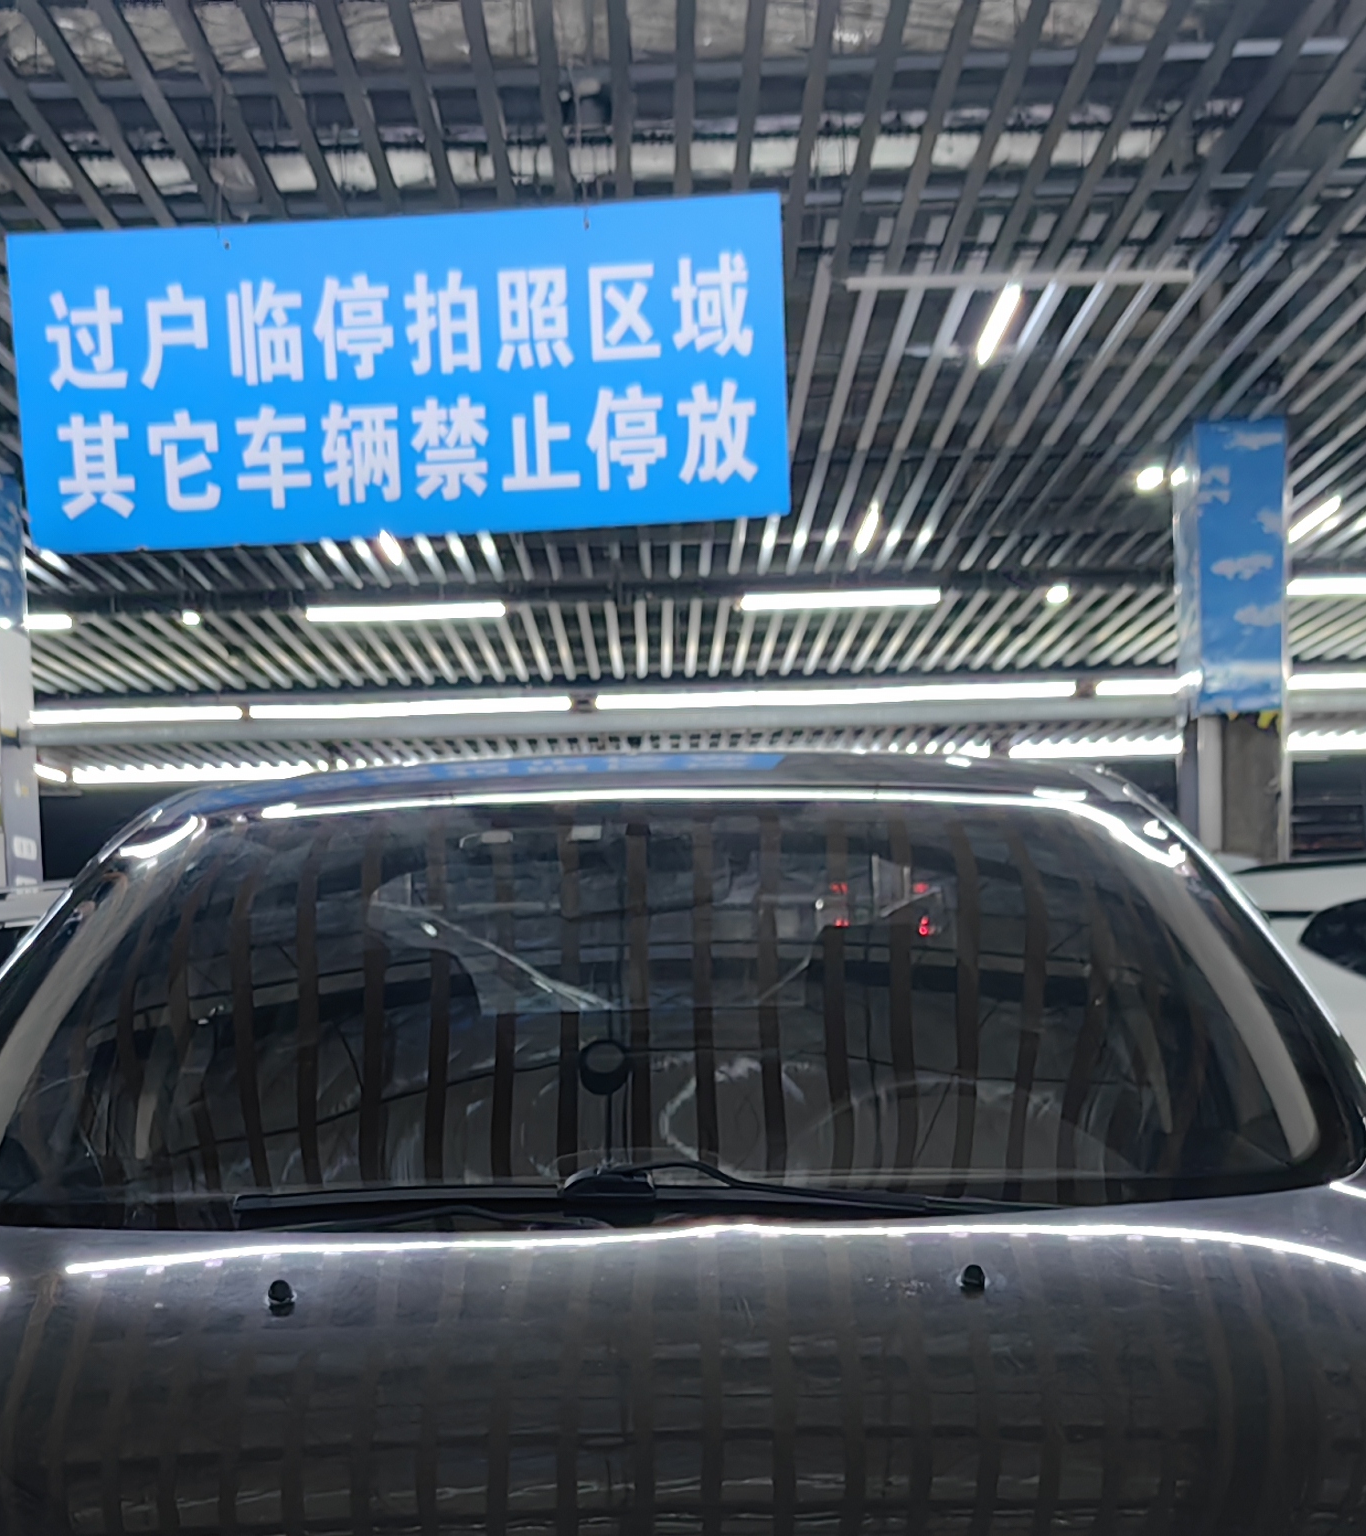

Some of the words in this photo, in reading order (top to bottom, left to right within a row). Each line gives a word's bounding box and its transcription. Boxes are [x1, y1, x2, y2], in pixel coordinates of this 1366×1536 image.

[45, 251, 756, 391] 过户临停拍照区域
[57, 379, 759, 520] 其它车辆禁止停放
